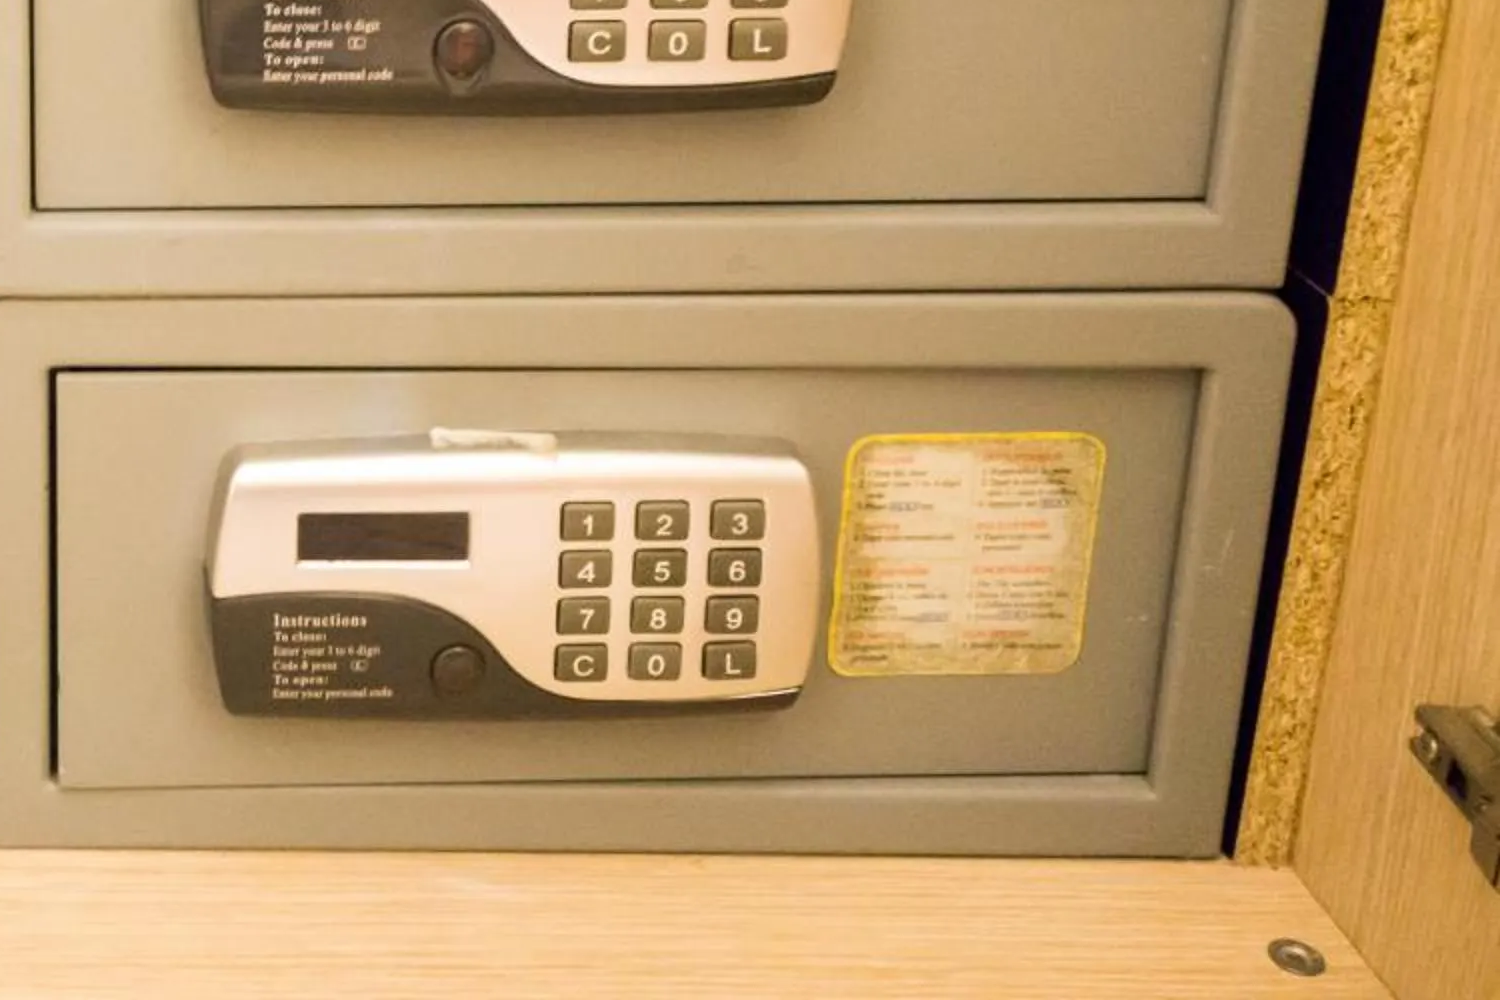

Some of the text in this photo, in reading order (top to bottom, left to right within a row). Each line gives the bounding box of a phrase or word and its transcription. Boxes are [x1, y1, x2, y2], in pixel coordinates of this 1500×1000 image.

[264, 3, 280, 16] To
[588, 29, 771, 55] C 0 L
[264, 53, 281, 65] To
[583, 513, 748, 536] 1 2 3
[577, 561, 746, 582] 4 5 6
[273, 612, 367, 628] Instructions
[580, 608, 743, 630] 7 8 9
[274, 631, 288, 642] To
[573, 654, 740, 676] C 0 L
[273, 674, 289, 685] To
